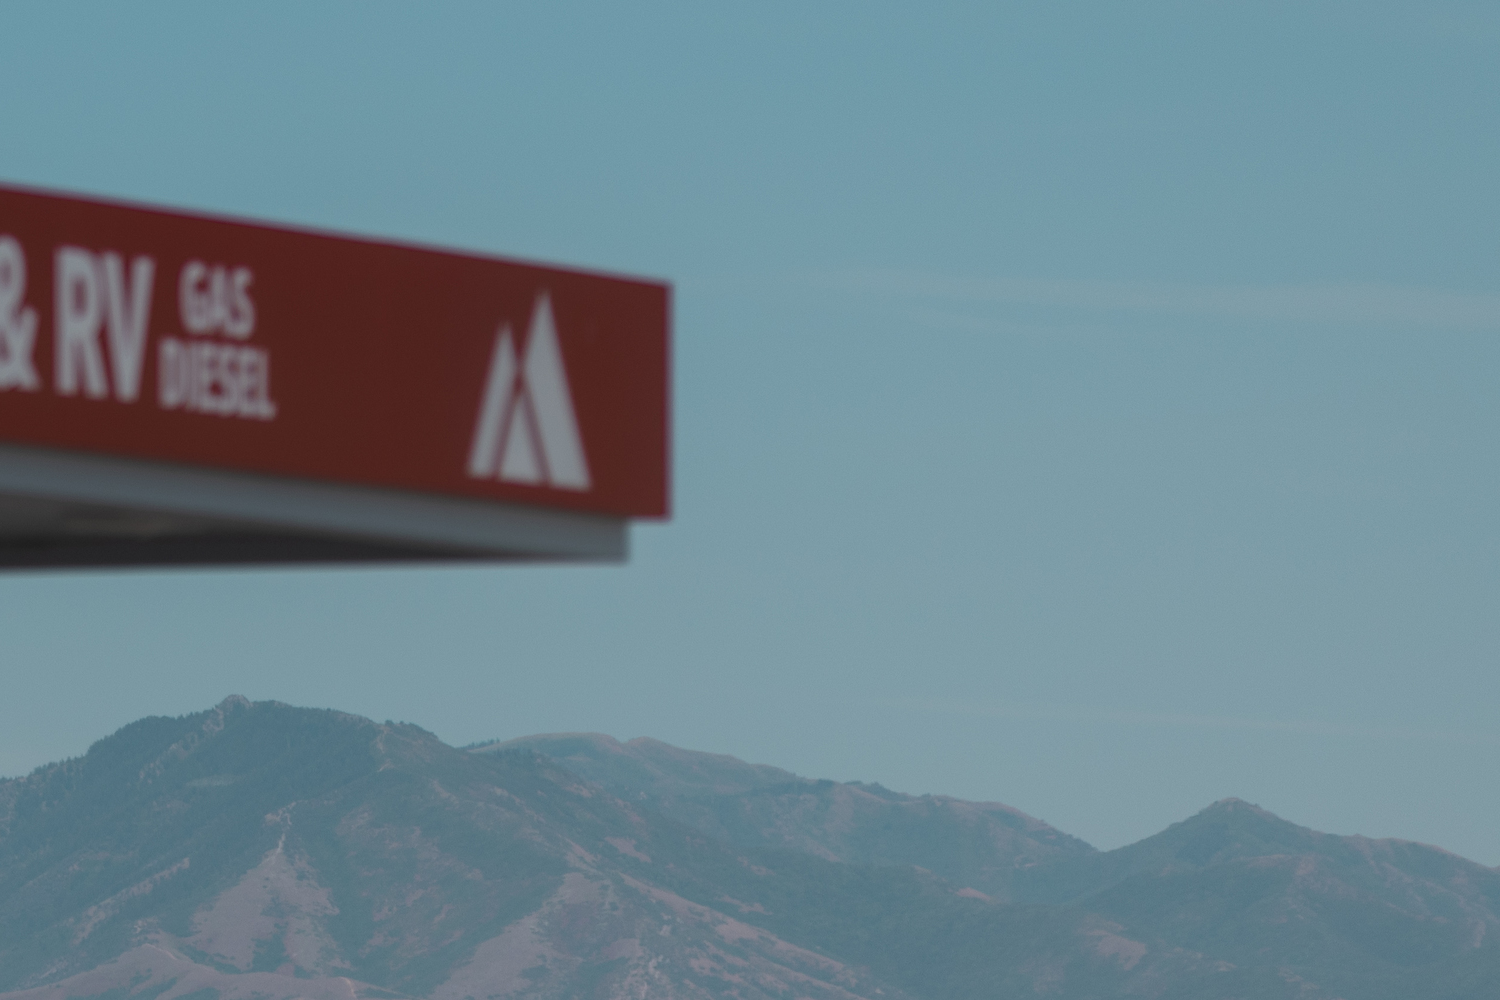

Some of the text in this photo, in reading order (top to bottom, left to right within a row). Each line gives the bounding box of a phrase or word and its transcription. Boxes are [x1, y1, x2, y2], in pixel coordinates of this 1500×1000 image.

[54, 245, 155, 401] RV
[179, 260, 255, 339] GAS
[157, 337, 276, 420] DIESEL
